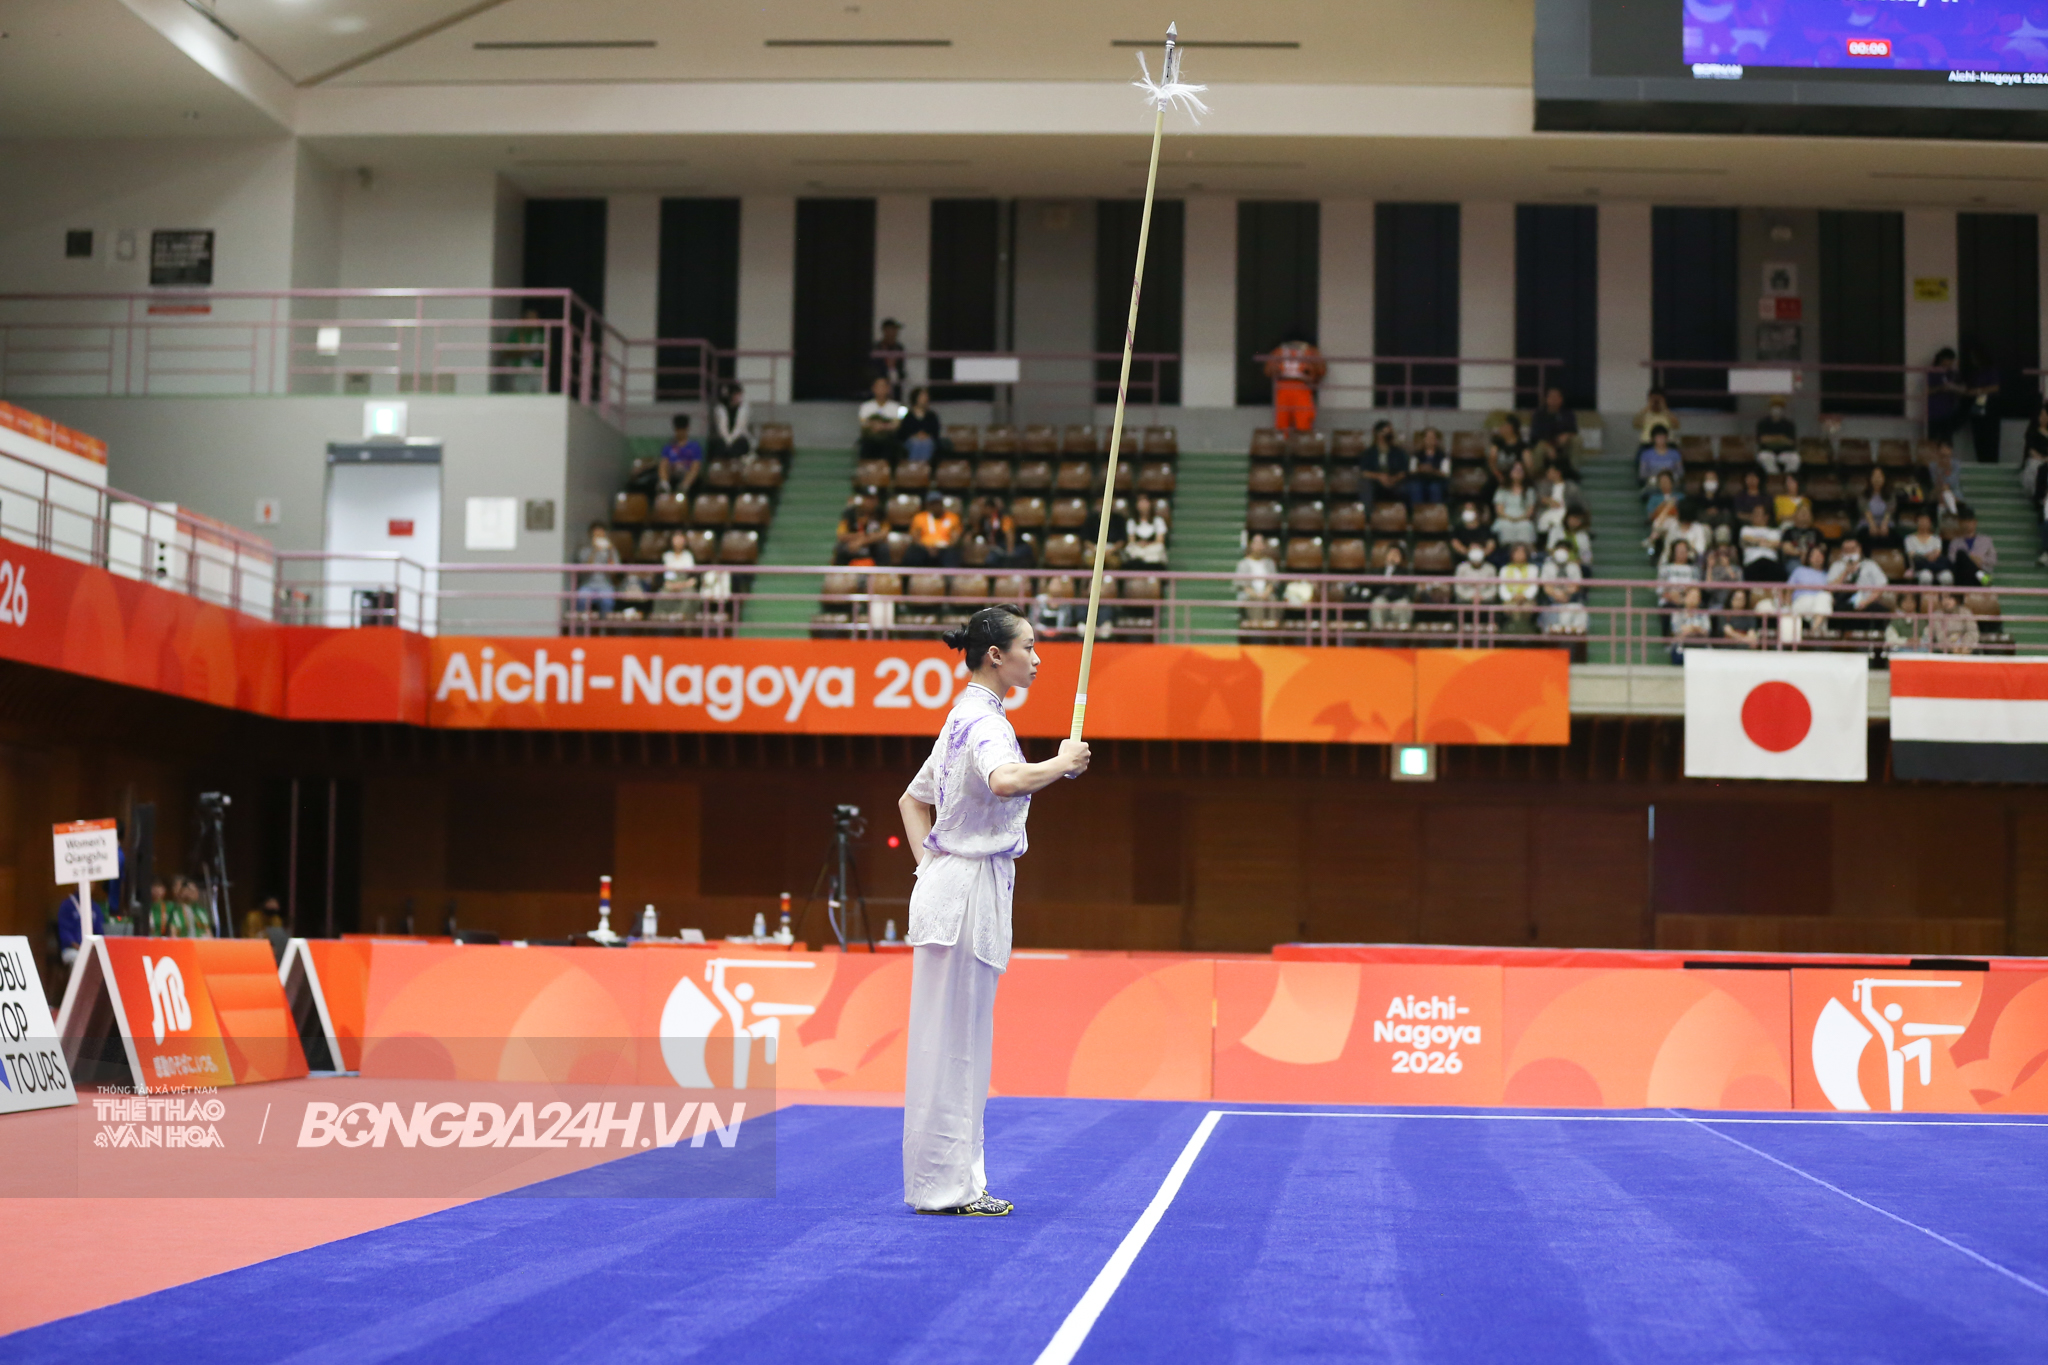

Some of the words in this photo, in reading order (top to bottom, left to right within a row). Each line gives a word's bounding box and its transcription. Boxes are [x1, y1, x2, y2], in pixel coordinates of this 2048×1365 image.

[1849, 42, 1888, 55] 00:00
[1948, 70, 2021, 86] Aichi-Nagoya
[436, 647, 855, 723] Aichi-Nagoya
[65, 837, 106, 849] Women's
[0, 951, 27, 991] BU
[1386, 995, 1470, 1020] Aichi-
[1373, 1020, 1482, 1050] Nagoya
[6, 1050, 67, 1095] TOURS
[1391, 1050, 1463, 1074] 2026
